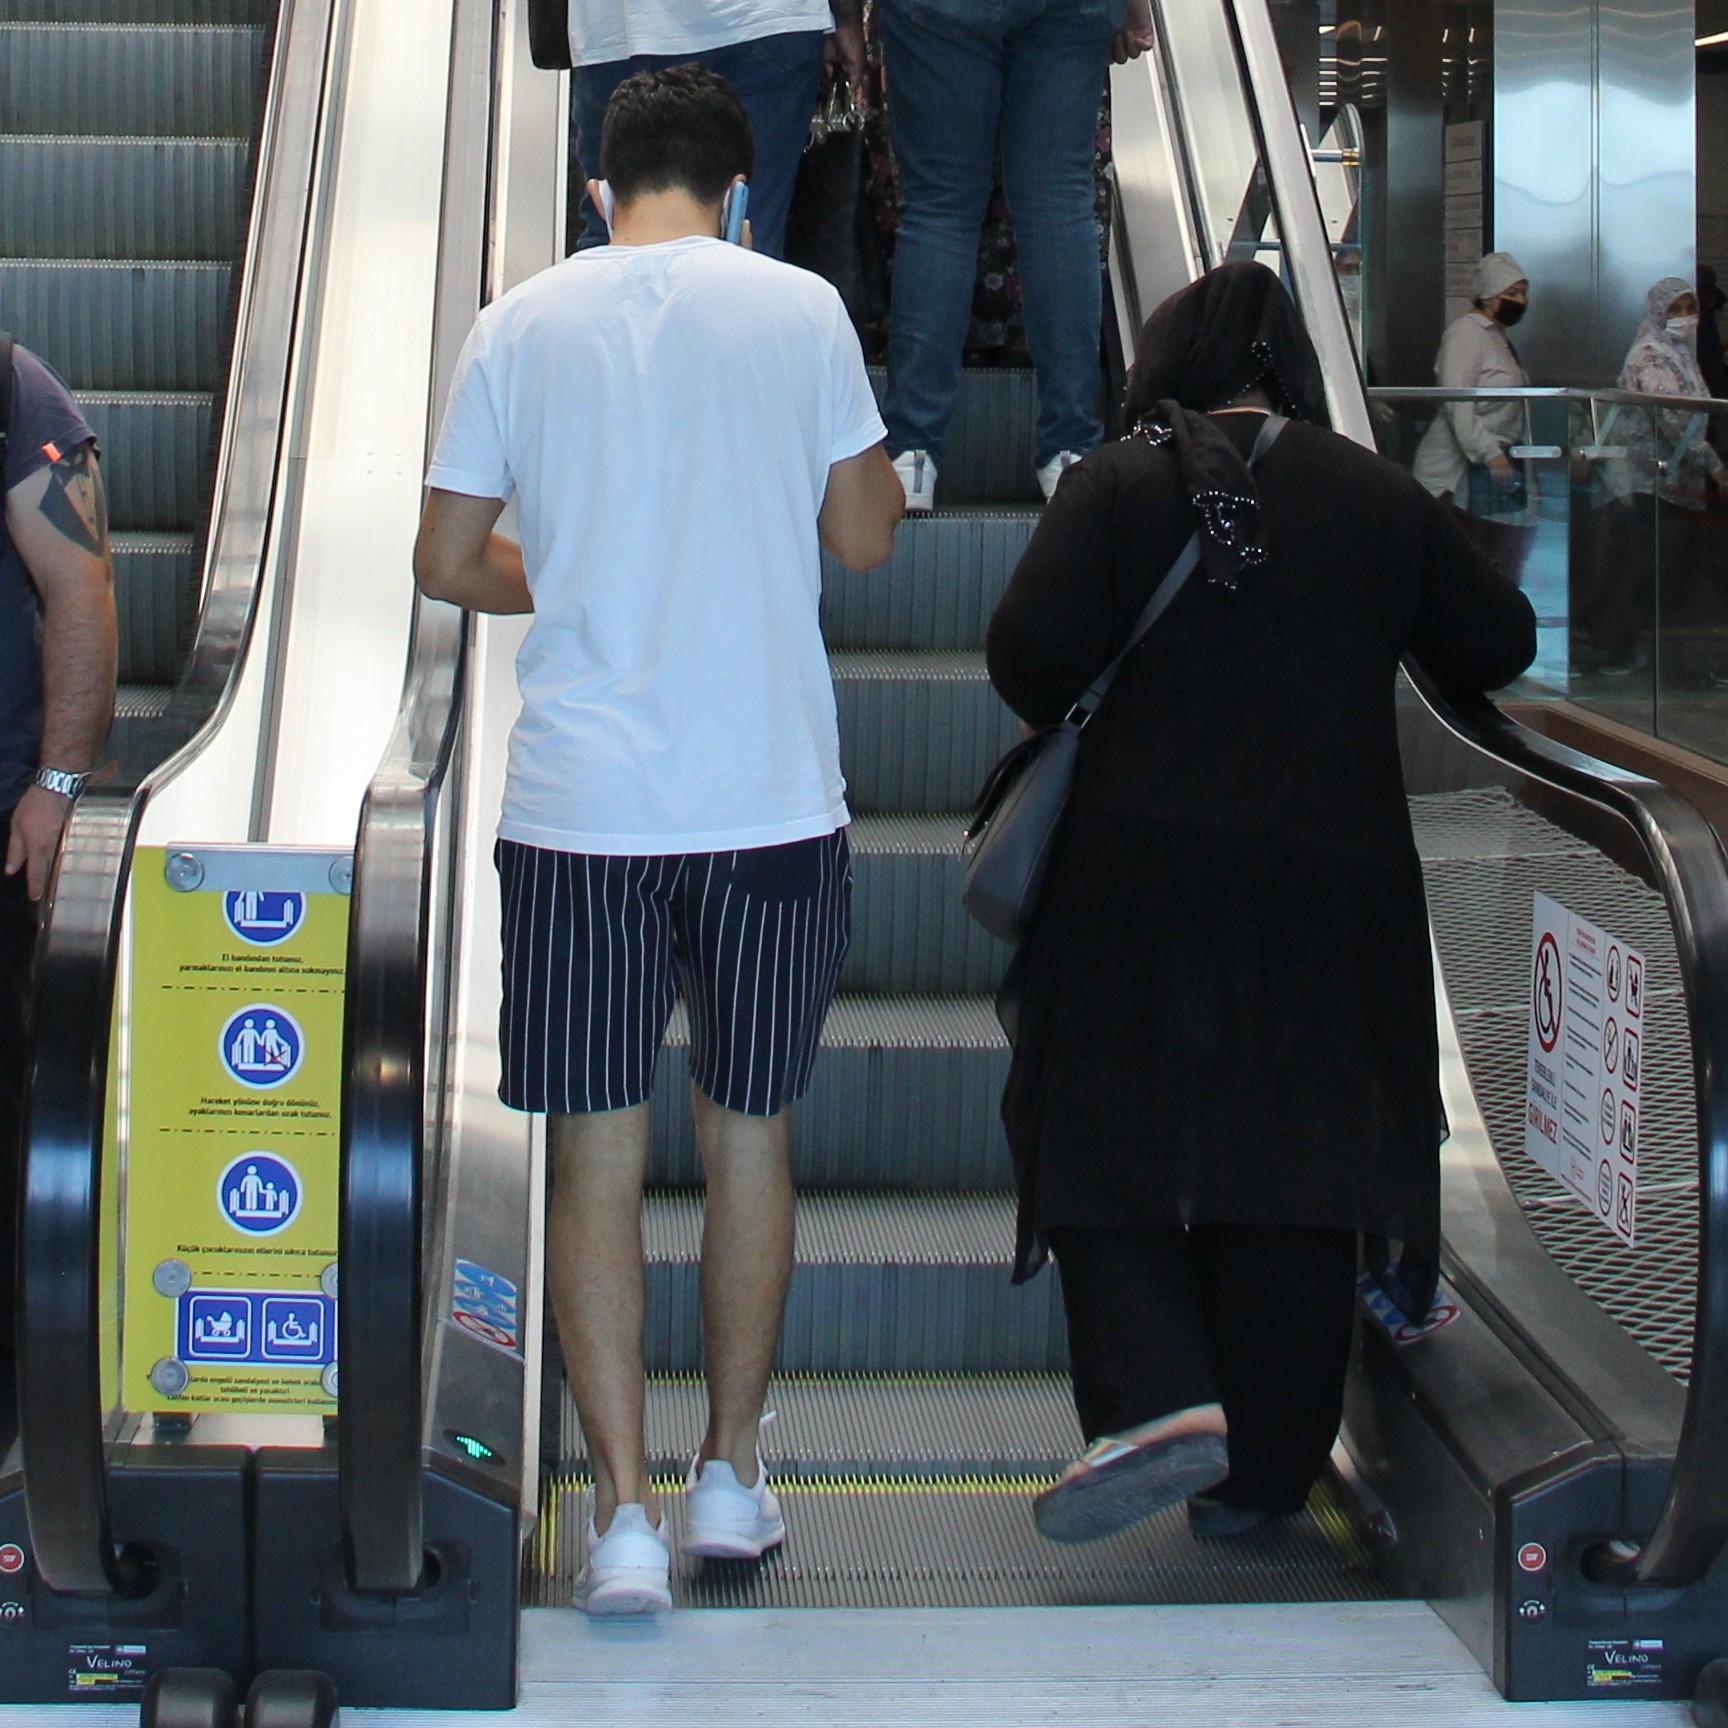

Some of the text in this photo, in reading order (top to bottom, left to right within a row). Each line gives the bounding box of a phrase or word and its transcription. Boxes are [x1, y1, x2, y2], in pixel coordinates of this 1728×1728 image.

[222, 953, 230, 961] El
[232, 1097, 260, 1107] yönüne
[262, 1097, 284, 1107] doğru
[234, 1108, 279, 1116] kenarlardan
[281, 1109, 299, 1117] uzak
[177, 1244, 200, 1253] Küçük
[191, 1393, 211, 1401] katlar
